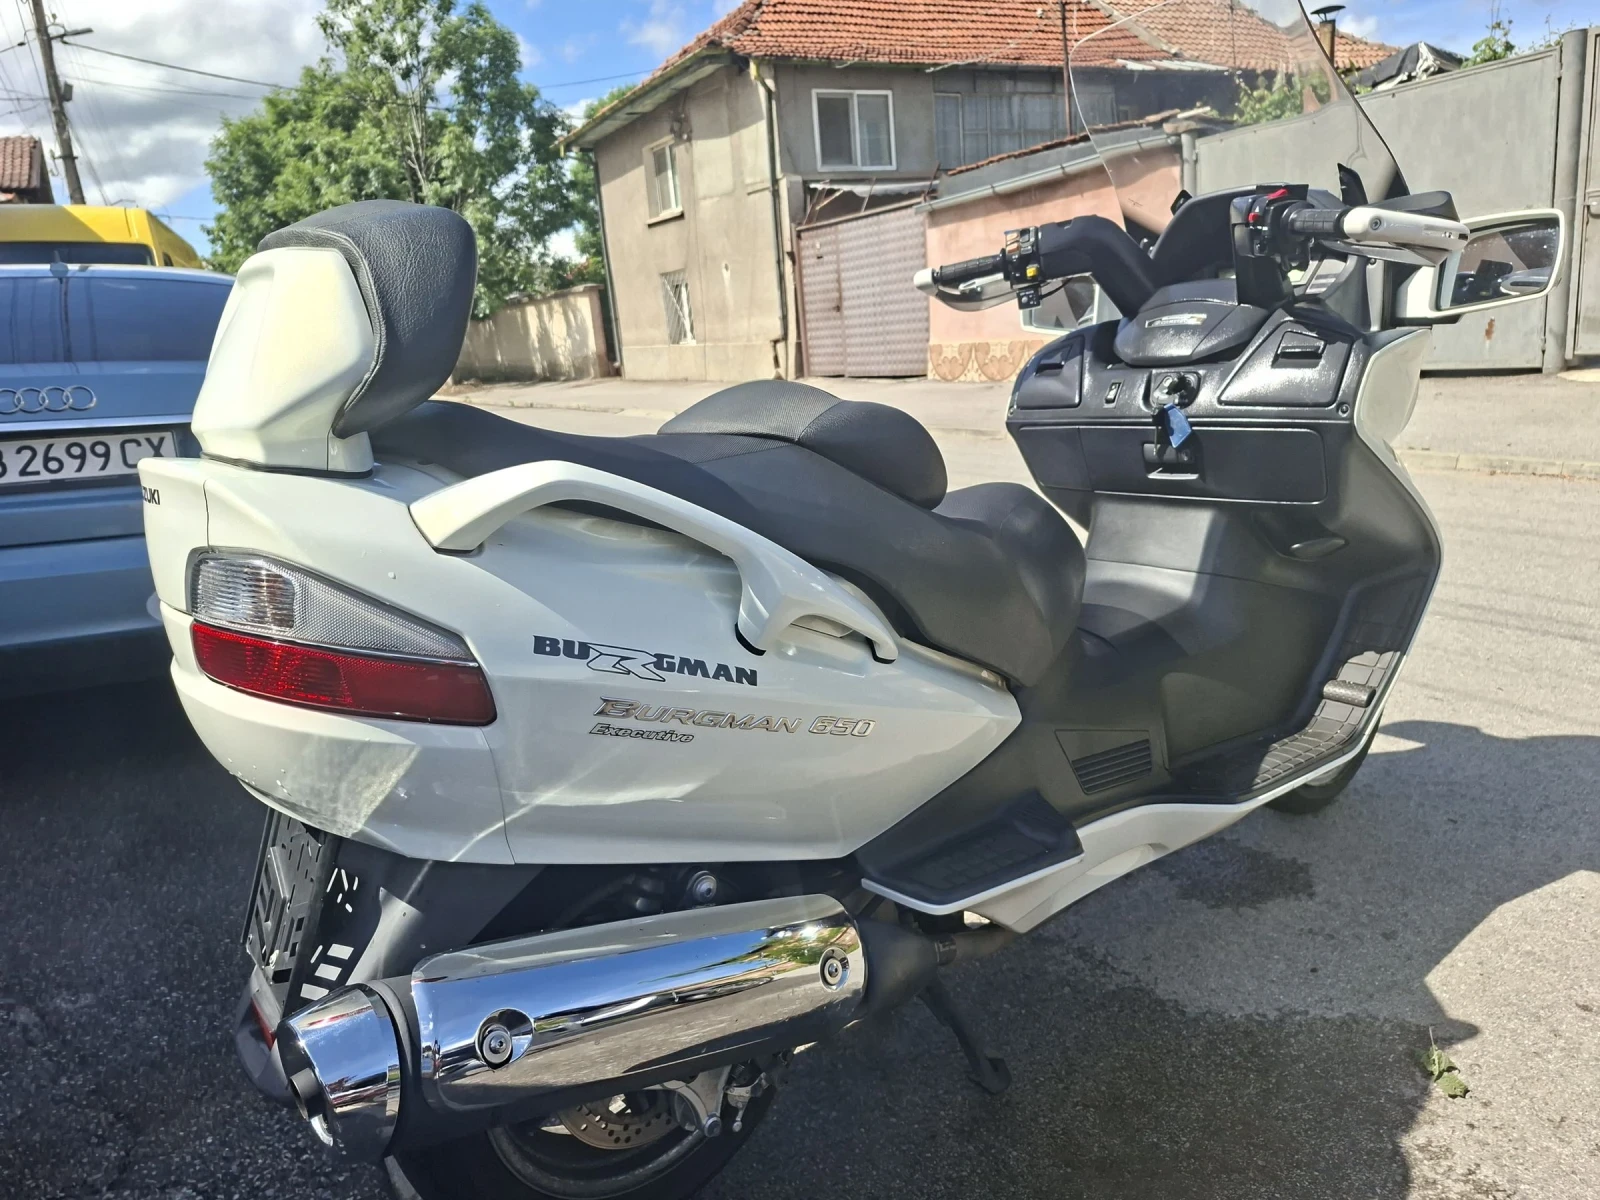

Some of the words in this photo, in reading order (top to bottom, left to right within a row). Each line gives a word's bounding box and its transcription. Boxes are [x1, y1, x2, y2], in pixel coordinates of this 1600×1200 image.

[15, 441, 111, 477] 2699
[142, 486, 161, 505] ZUKI
[533, 635, 758, 686] BURGMAN
[589, 722, 694, 743] Executive
[593, 696, 802, 733] BURGMAN
[808, 715, 876, 737] 650
